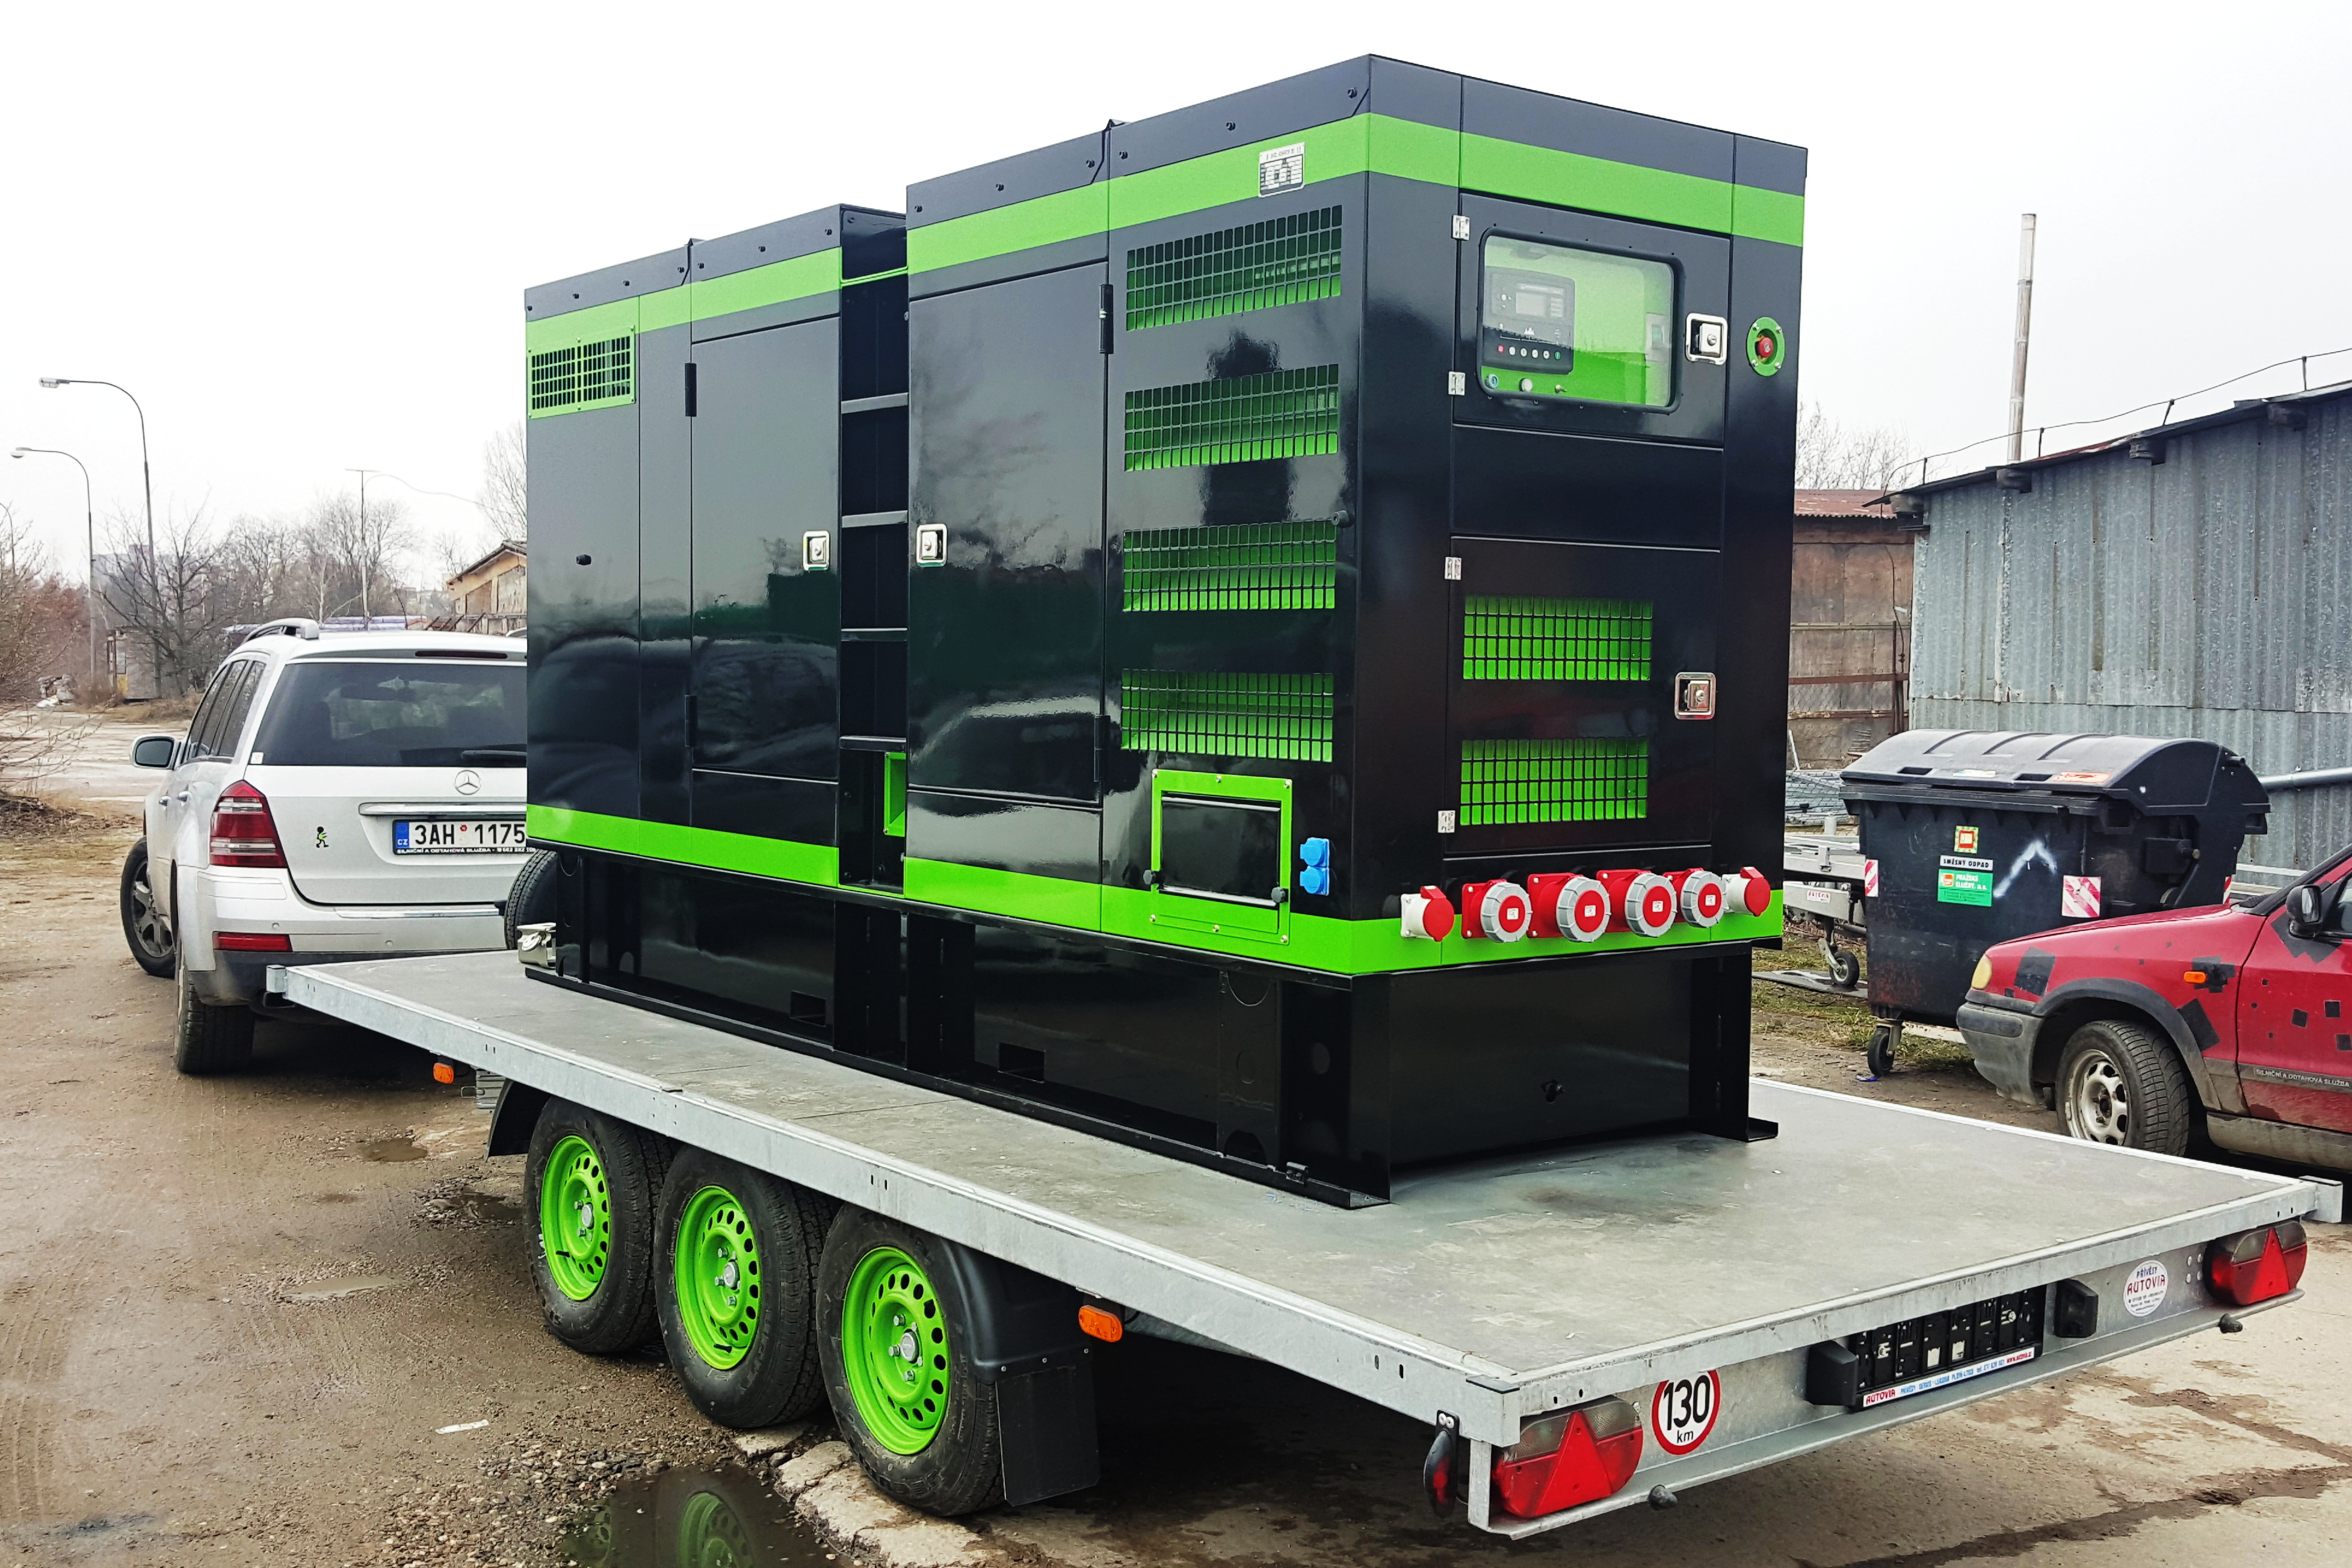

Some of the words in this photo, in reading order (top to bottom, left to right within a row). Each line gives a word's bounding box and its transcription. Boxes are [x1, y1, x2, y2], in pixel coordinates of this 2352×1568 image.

[415, 824, 454, 845] 3AH
[475, 824, 525, 844] 1175
[2127, 1274, 2165, 1295] AUTOVIA
[1663, 1375, 1711, 1431] 130
[1866, 1389, 1895, 1404] AUTOVIA
[1677, 1430, 1694, 1443] km
